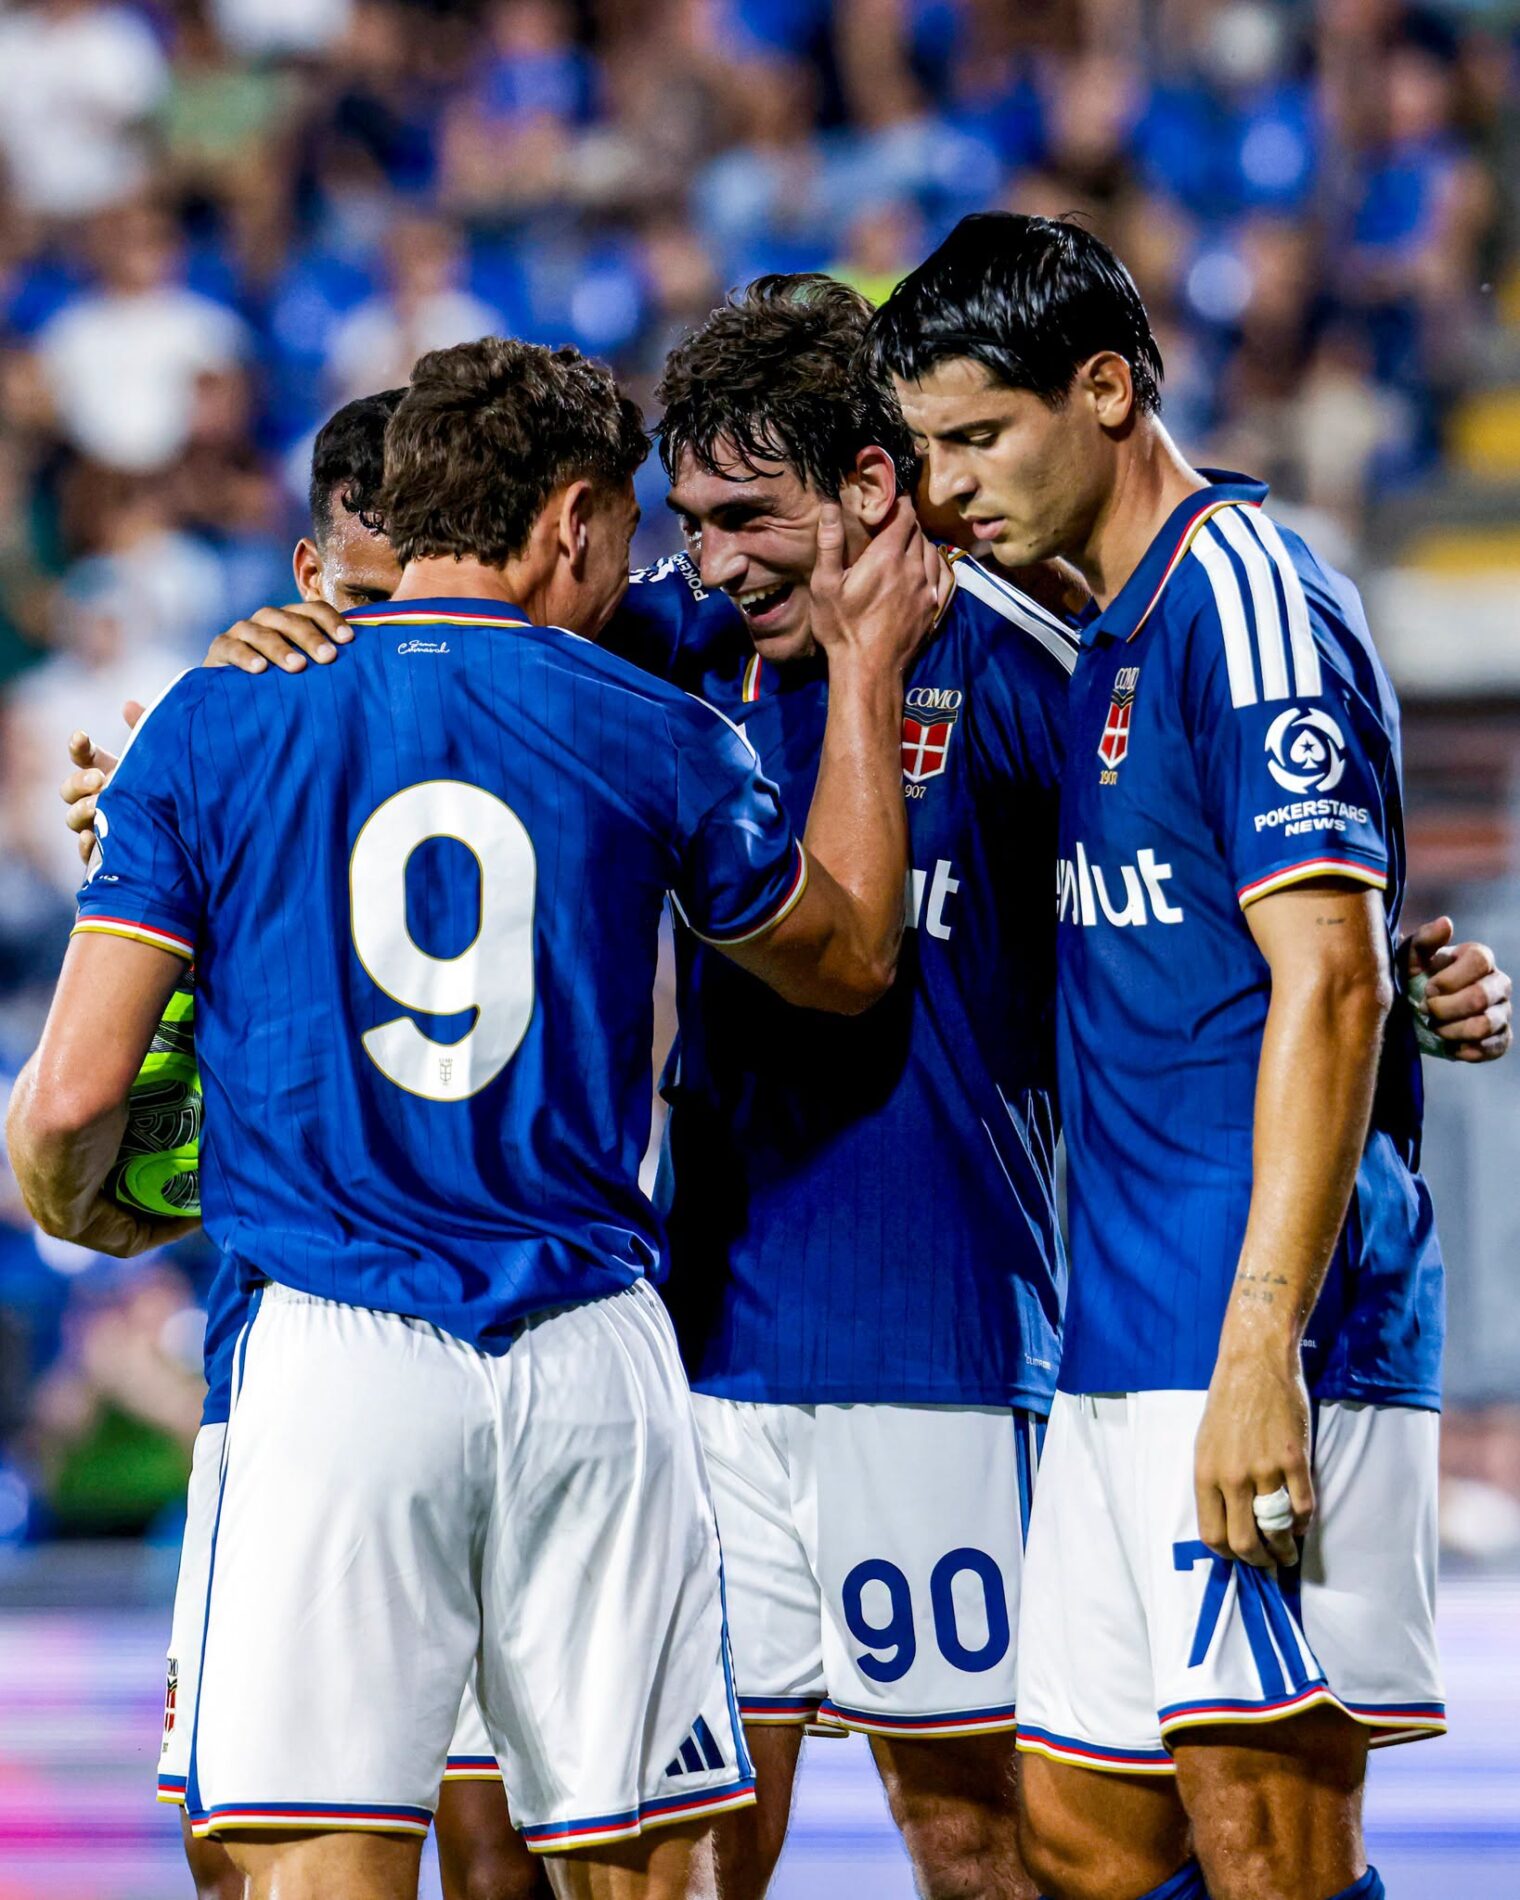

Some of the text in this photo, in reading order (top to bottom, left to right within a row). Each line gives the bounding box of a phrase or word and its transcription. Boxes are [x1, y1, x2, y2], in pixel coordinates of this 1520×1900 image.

[1114, 667, 1140, 690] COMO
[905, 687, 963, 710] COMO
[1098, 770, 1118, 785] 1907
[904, 784, 928, 799] 907
[1254, 799, 1369, 832] POKERSTARS
[1284, 818, 1347, 837] NEWS
[348, 779, 537, 1102] 9
[841, 1547, 1010, 1683] 90
[1172, 1539, 1236, 1668] 7
